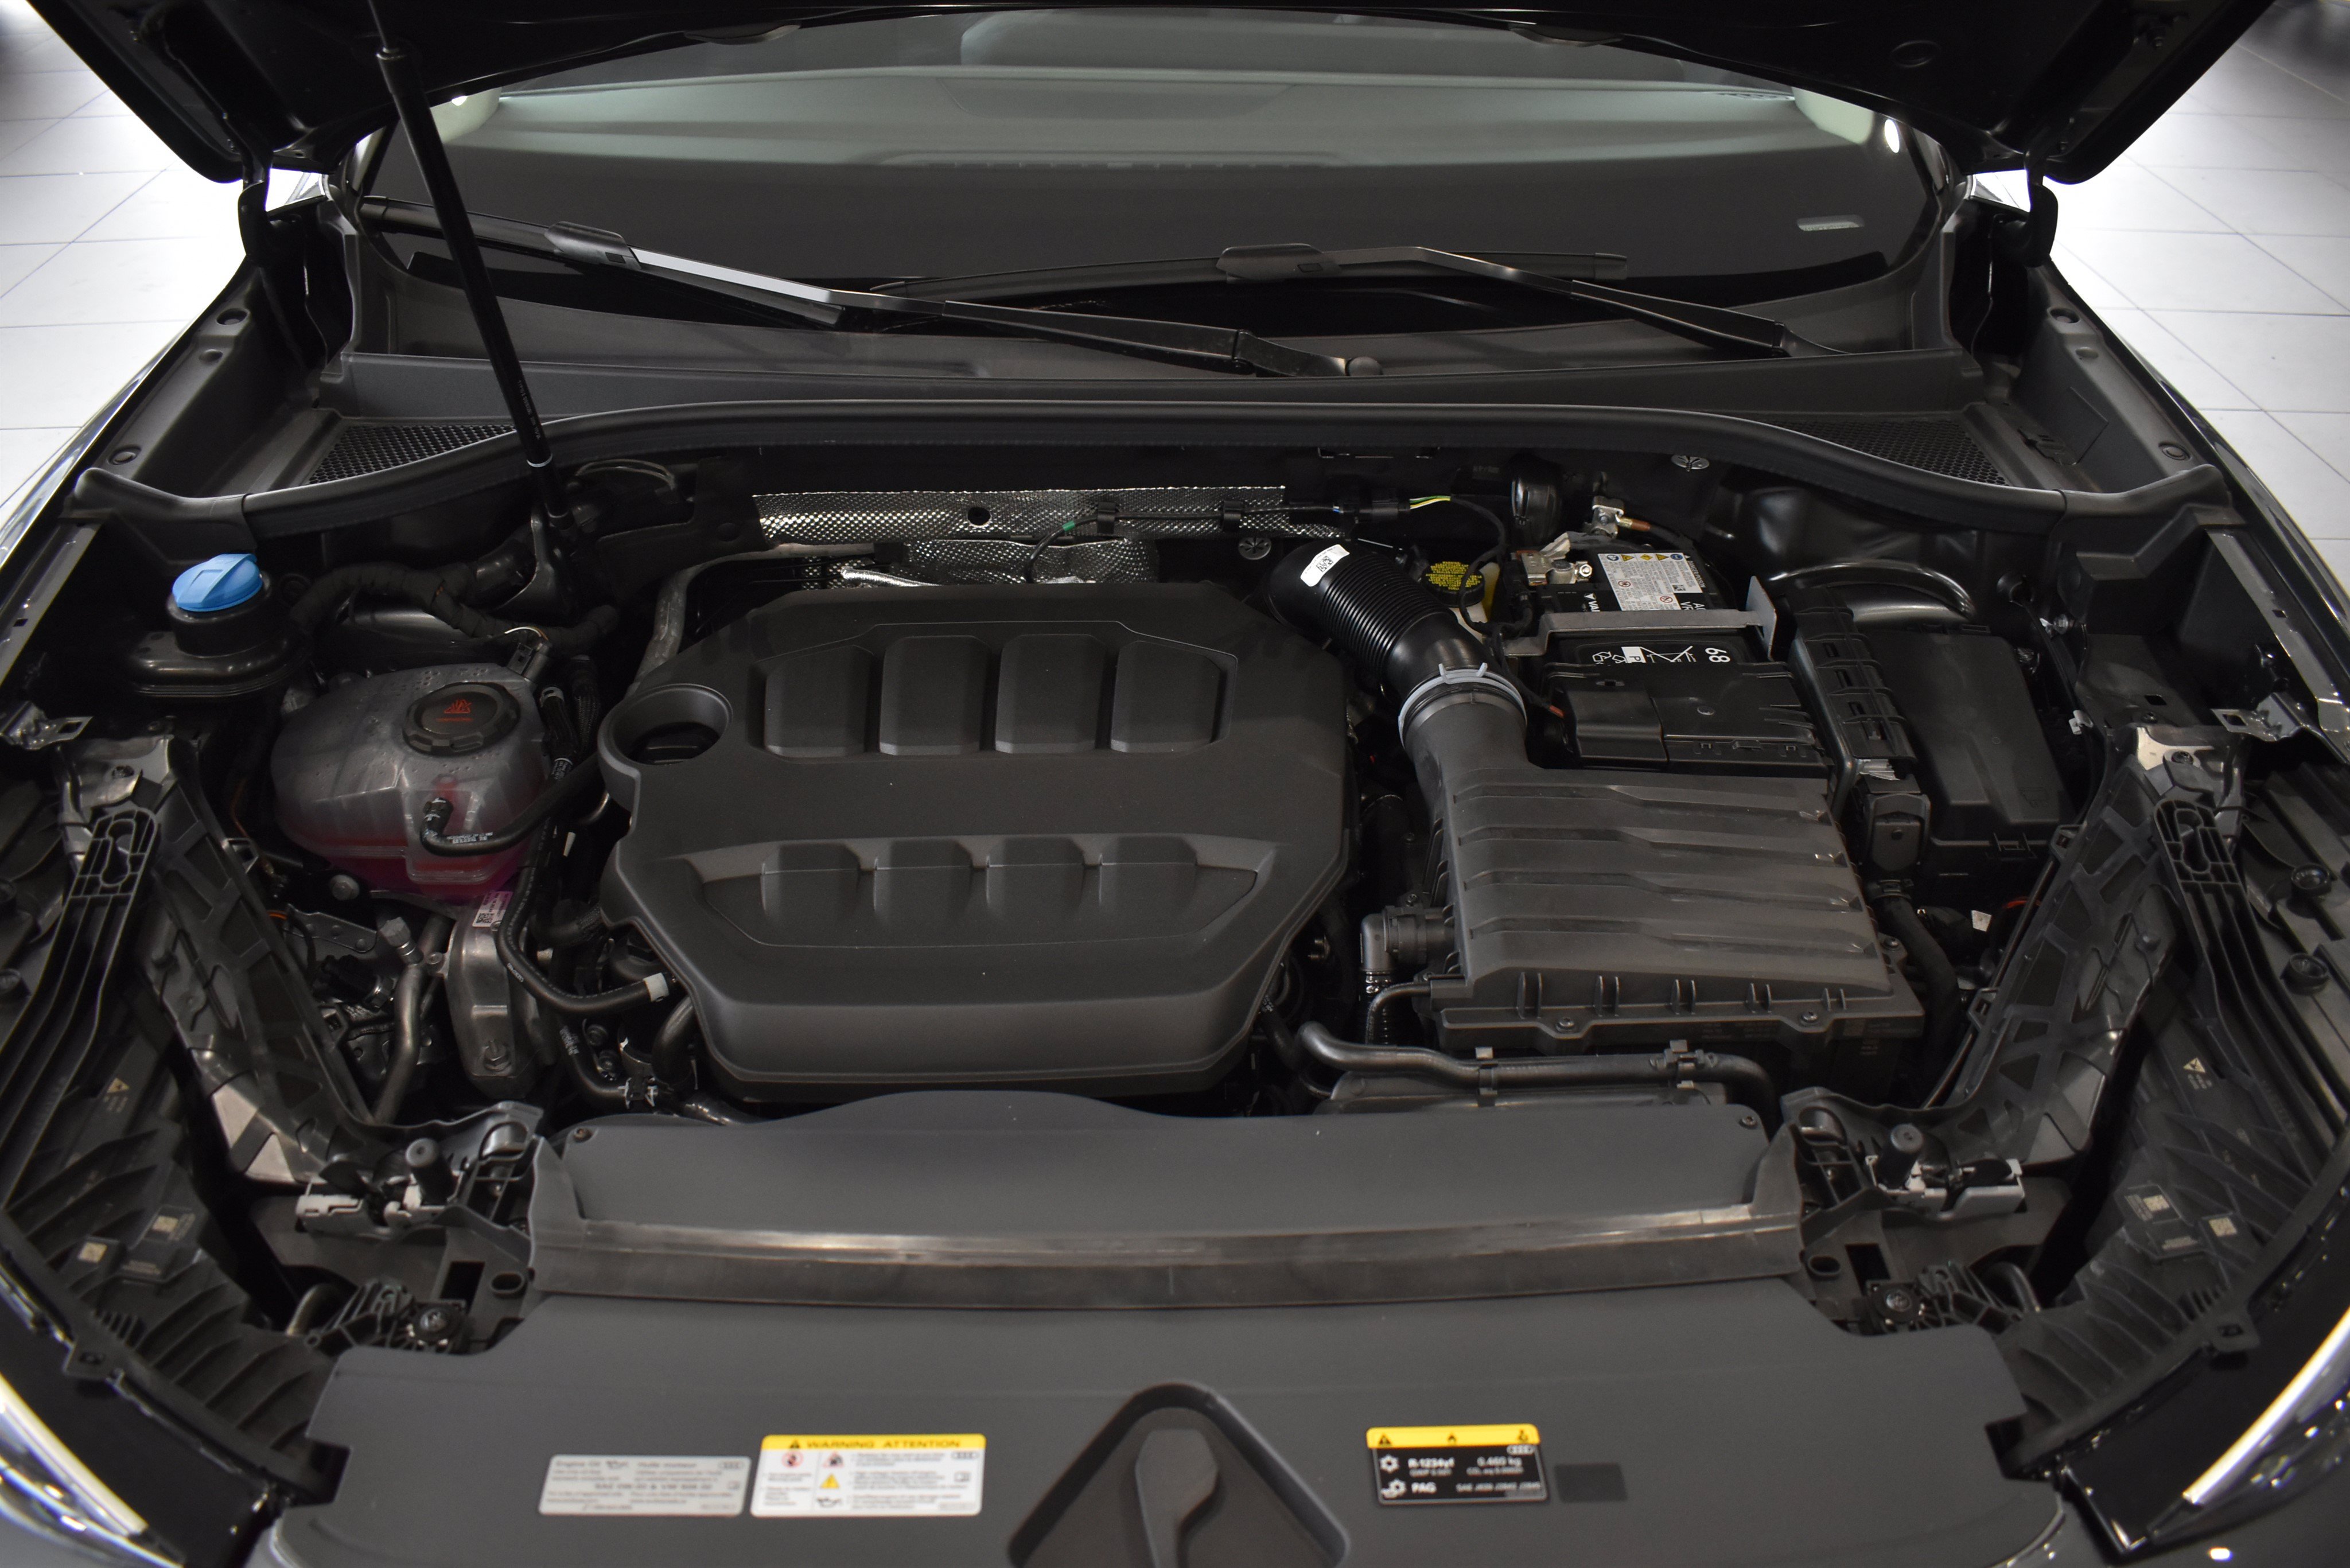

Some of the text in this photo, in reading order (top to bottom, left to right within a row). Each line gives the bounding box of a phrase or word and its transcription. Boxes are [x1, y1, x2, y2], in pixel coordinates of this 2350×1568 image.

[1705, 648, 1730, 663] 68
[808, 1439, 960, 1448] WARNING ATTENTION
[1411, 1482, 1437, 1493] PAG
